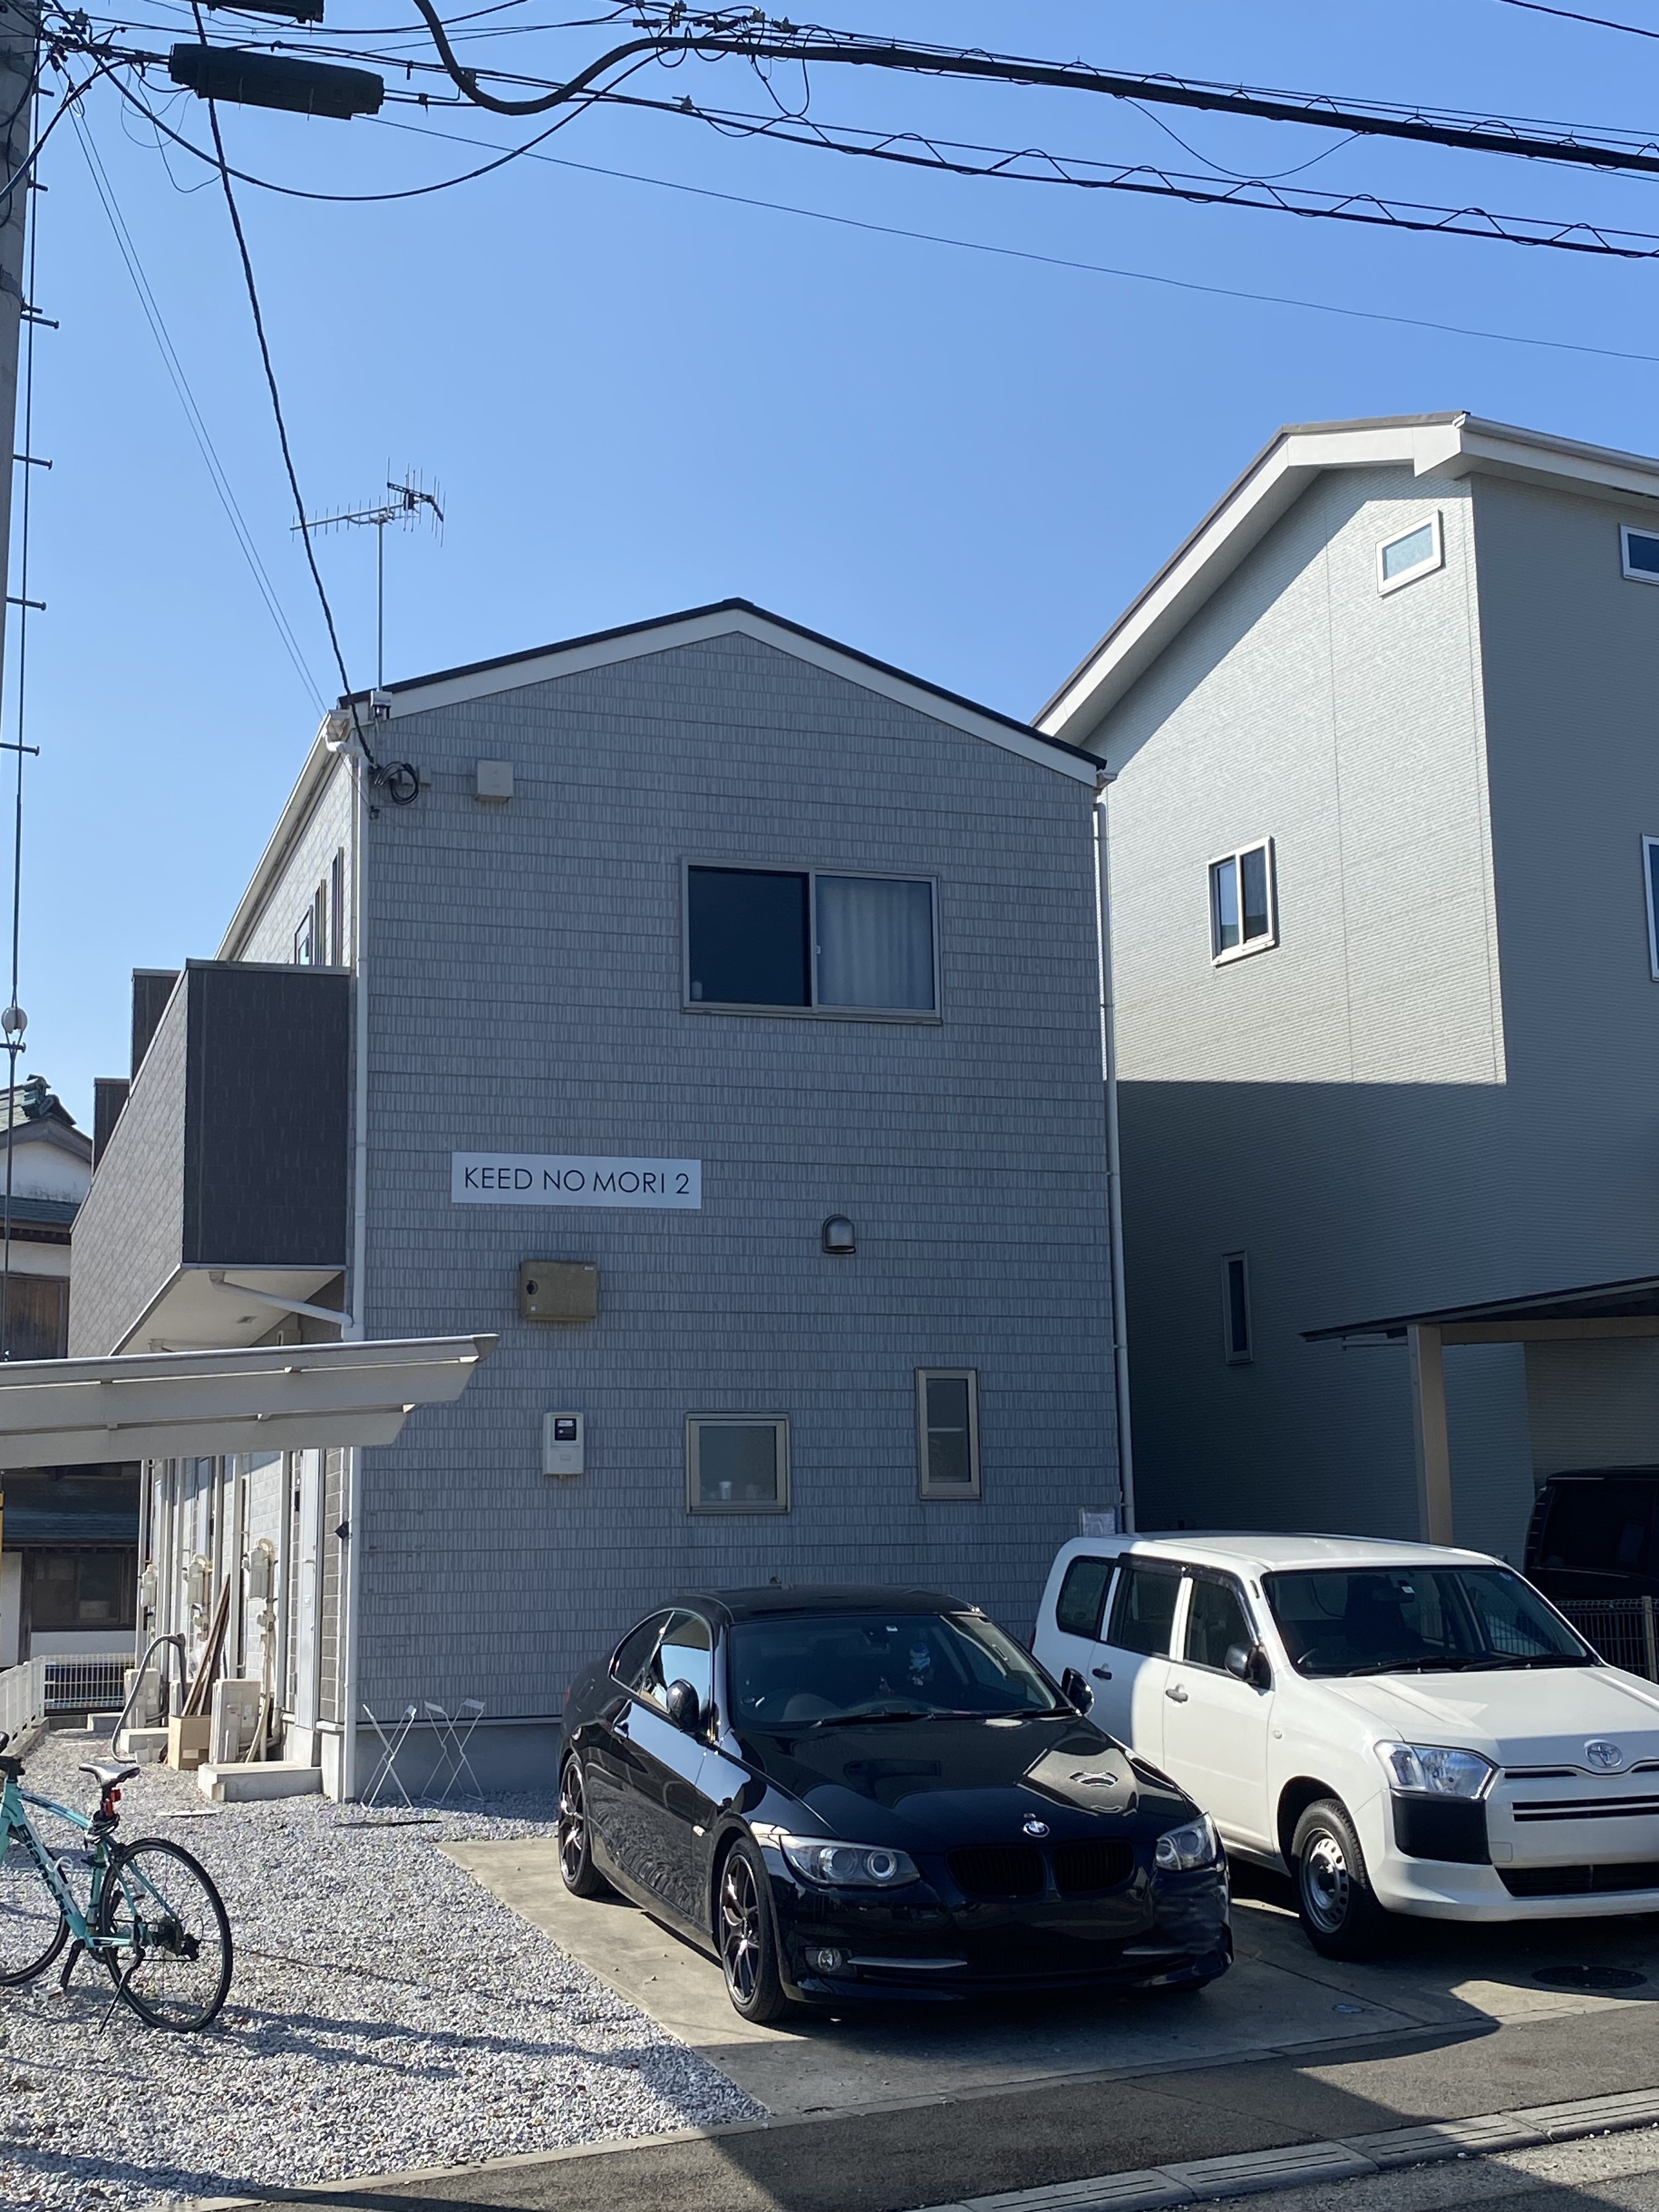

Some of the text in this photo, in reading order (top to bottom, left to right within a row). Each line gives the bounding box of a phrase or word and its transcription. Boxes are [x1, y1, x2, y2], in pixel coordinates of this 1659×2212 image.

[465, 1167, 690, 1194] KEED NO MORI 2
[17, 1824, 72, 1916] Bianchi
